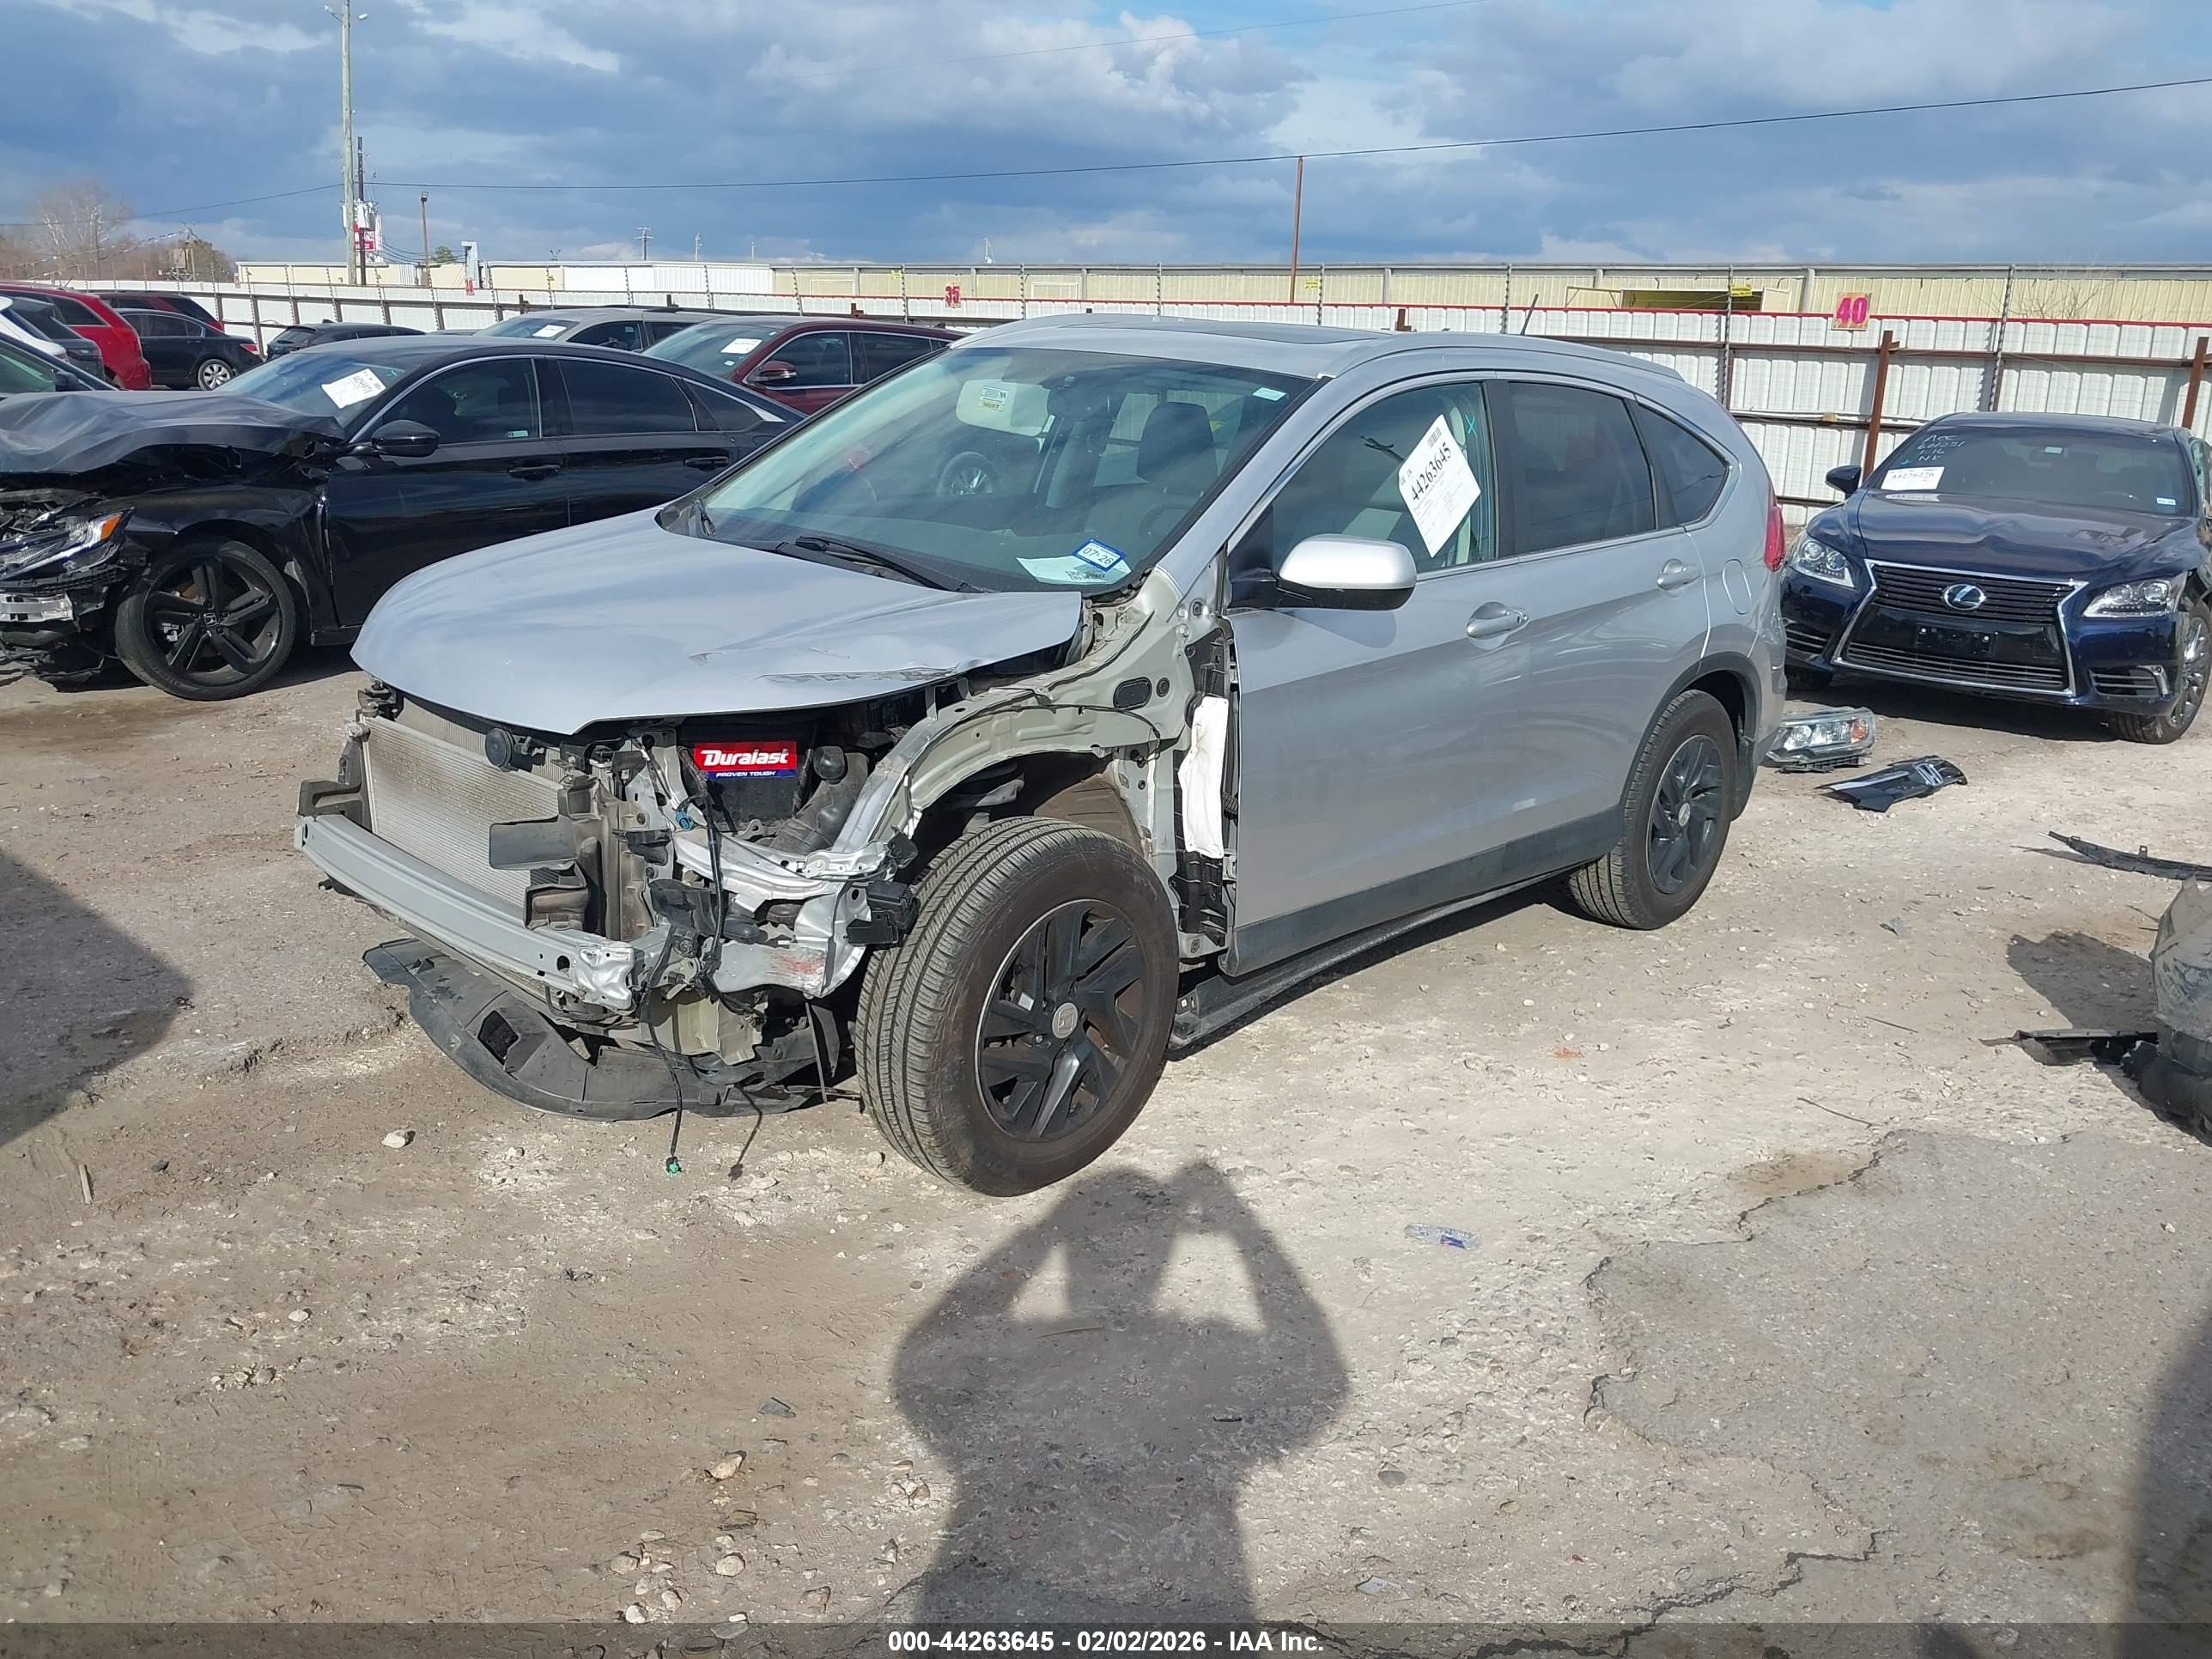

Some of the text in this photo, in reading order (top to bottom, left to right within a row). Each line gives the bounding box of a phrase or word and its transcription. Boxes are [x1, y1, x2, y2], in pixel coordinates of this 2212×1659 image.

[945, 285, 960, 304] 35
[1836, 297, 1867, 324] 40
[1411, 441, 1452, 501] 44263645
[700, 748, 790, 767] Duralast
